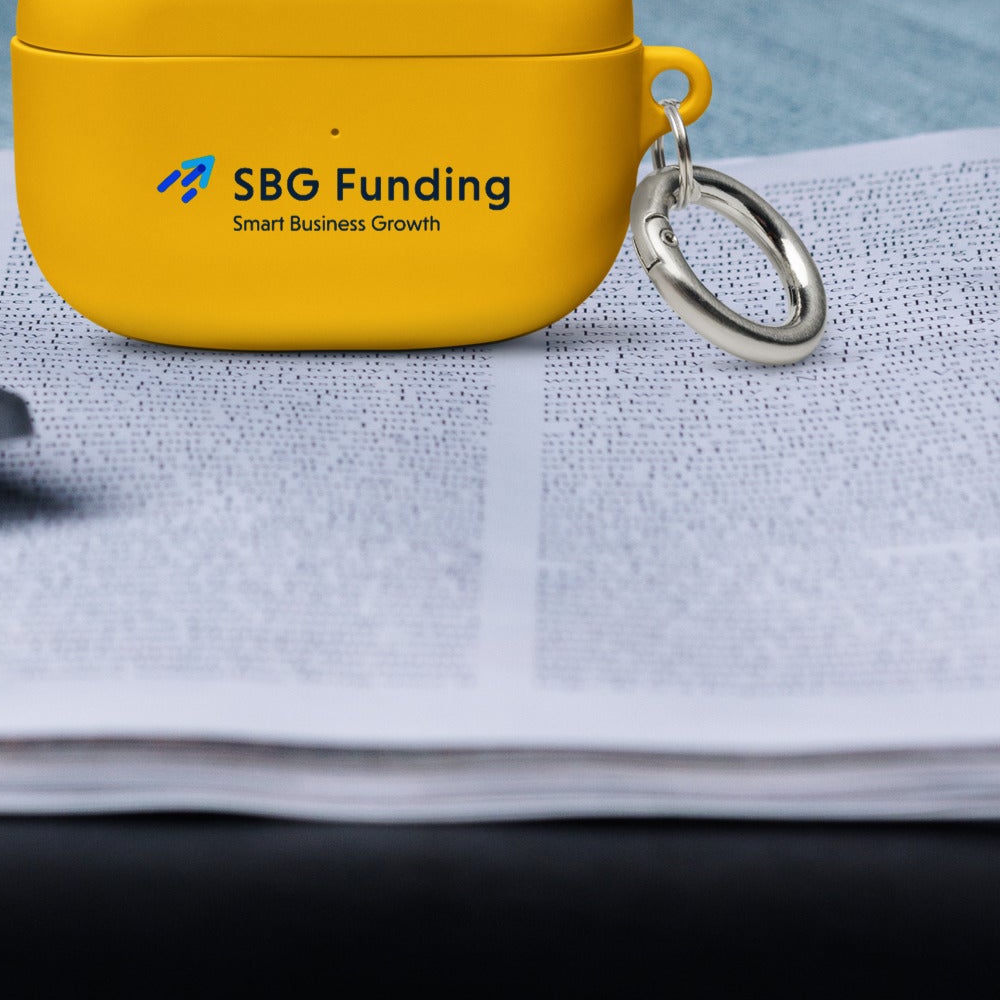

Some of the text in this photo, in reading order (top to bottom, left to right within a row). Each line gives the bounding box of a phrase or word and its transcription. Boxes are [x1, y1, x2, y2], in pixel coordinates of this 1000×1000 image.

[233, 166, 511, 211] SBG Funding
[233, 215, 441, 232] Smart Business Growth
[544, 338, 700, 346] powerhouse
[544, 360, 703, 369] additionally
